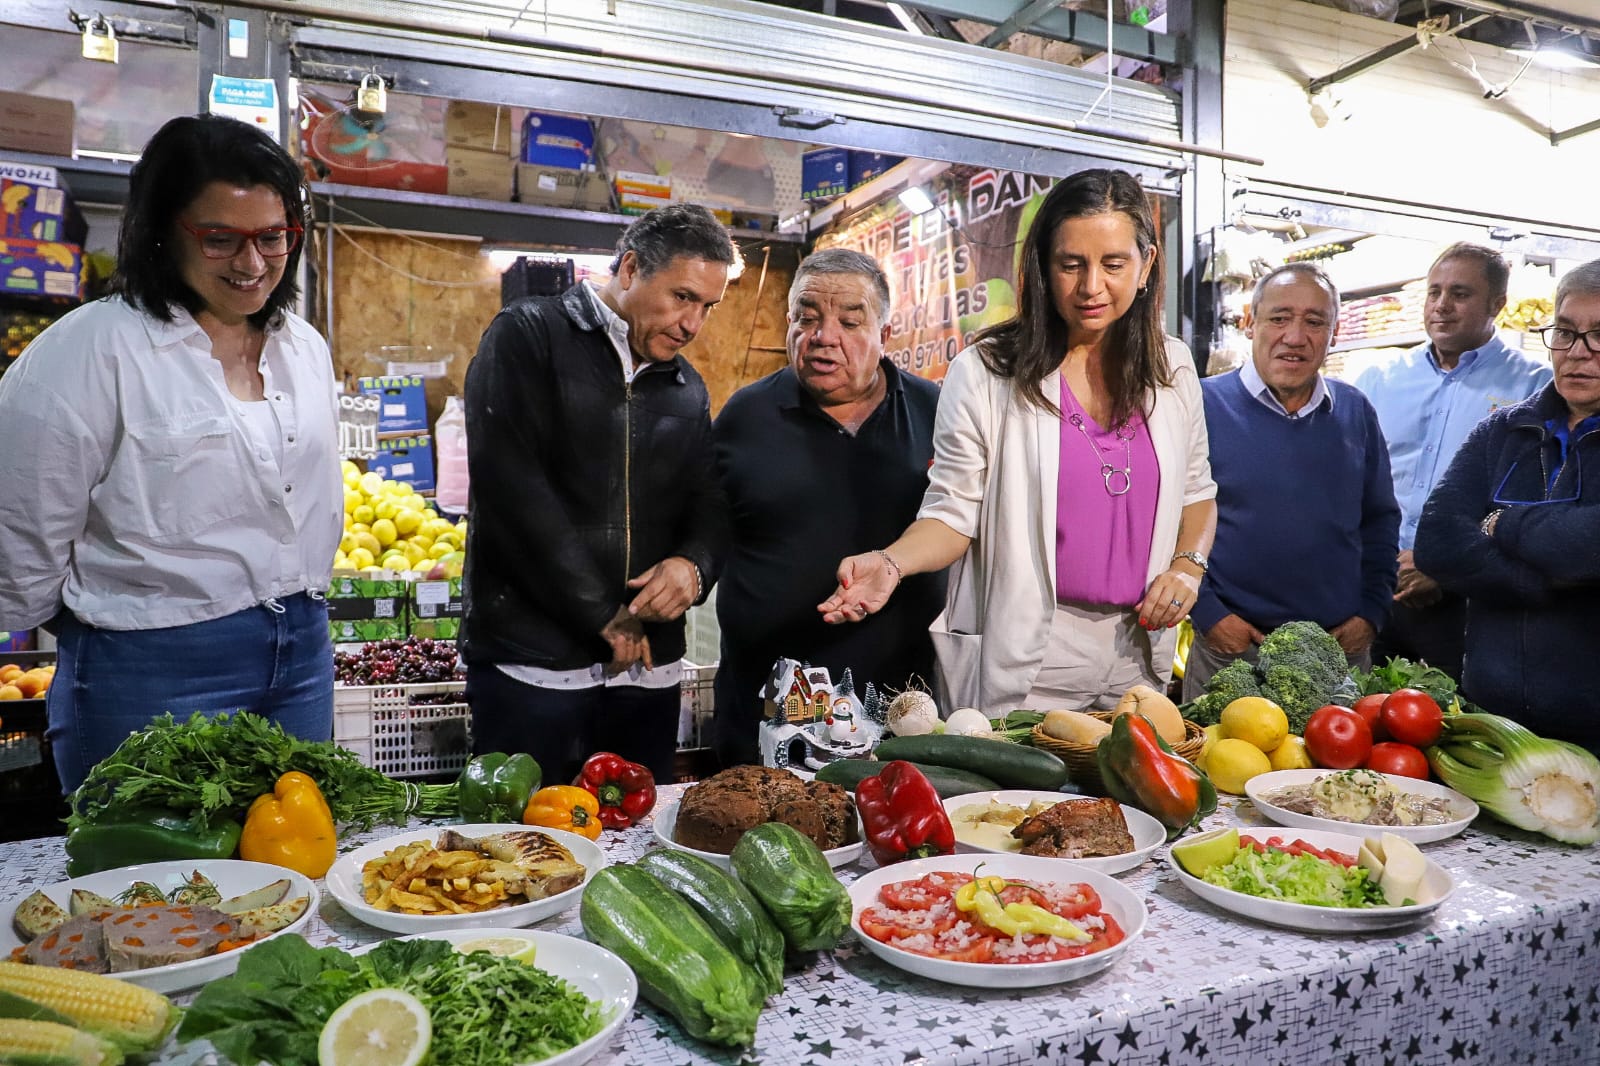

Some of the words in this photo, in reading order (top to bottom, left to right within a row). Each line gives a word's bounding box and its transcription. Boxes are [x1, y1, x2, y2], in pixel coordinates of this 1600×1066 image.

[221, 87, 244, 97] PAGA
[915, 335, 958, 370] 9710
[363, 377, 421, 390] NEVADO
